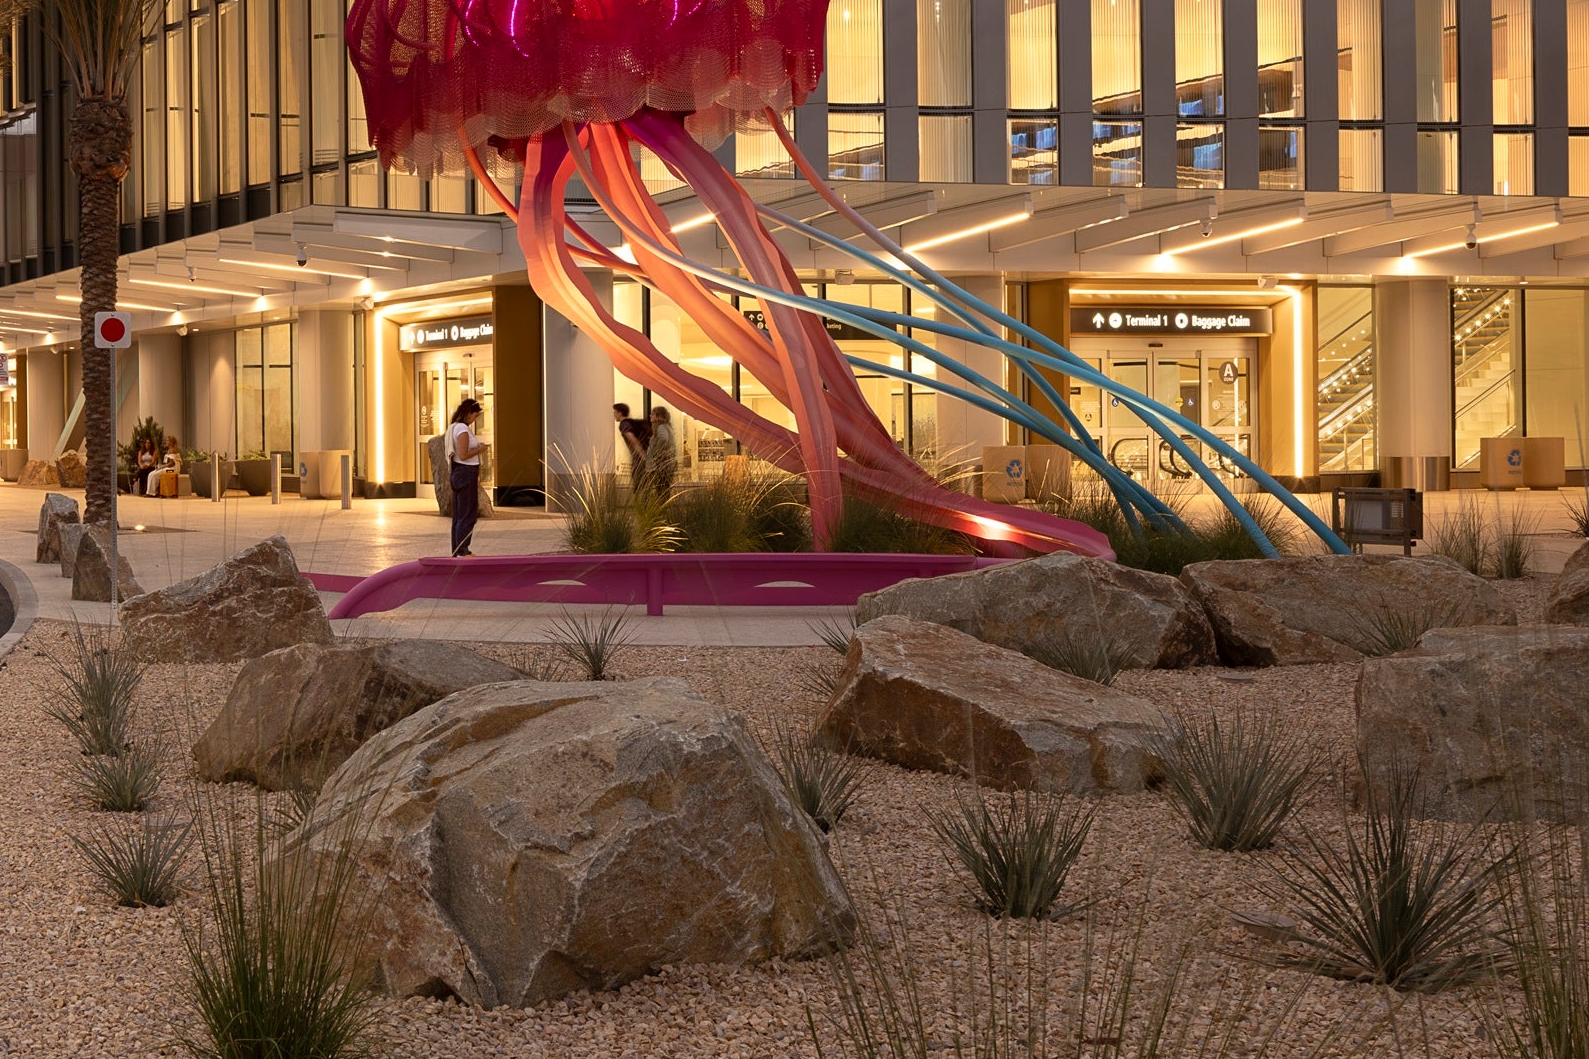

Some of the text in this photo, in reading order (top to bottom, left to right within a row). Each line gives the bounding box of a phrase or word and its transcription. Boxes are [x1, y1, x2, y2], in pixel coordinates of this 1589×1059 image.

[1126, 314, 1250, 329] Terminal 1 Baggage Claim
[1223, 363, 1234, 377] A
